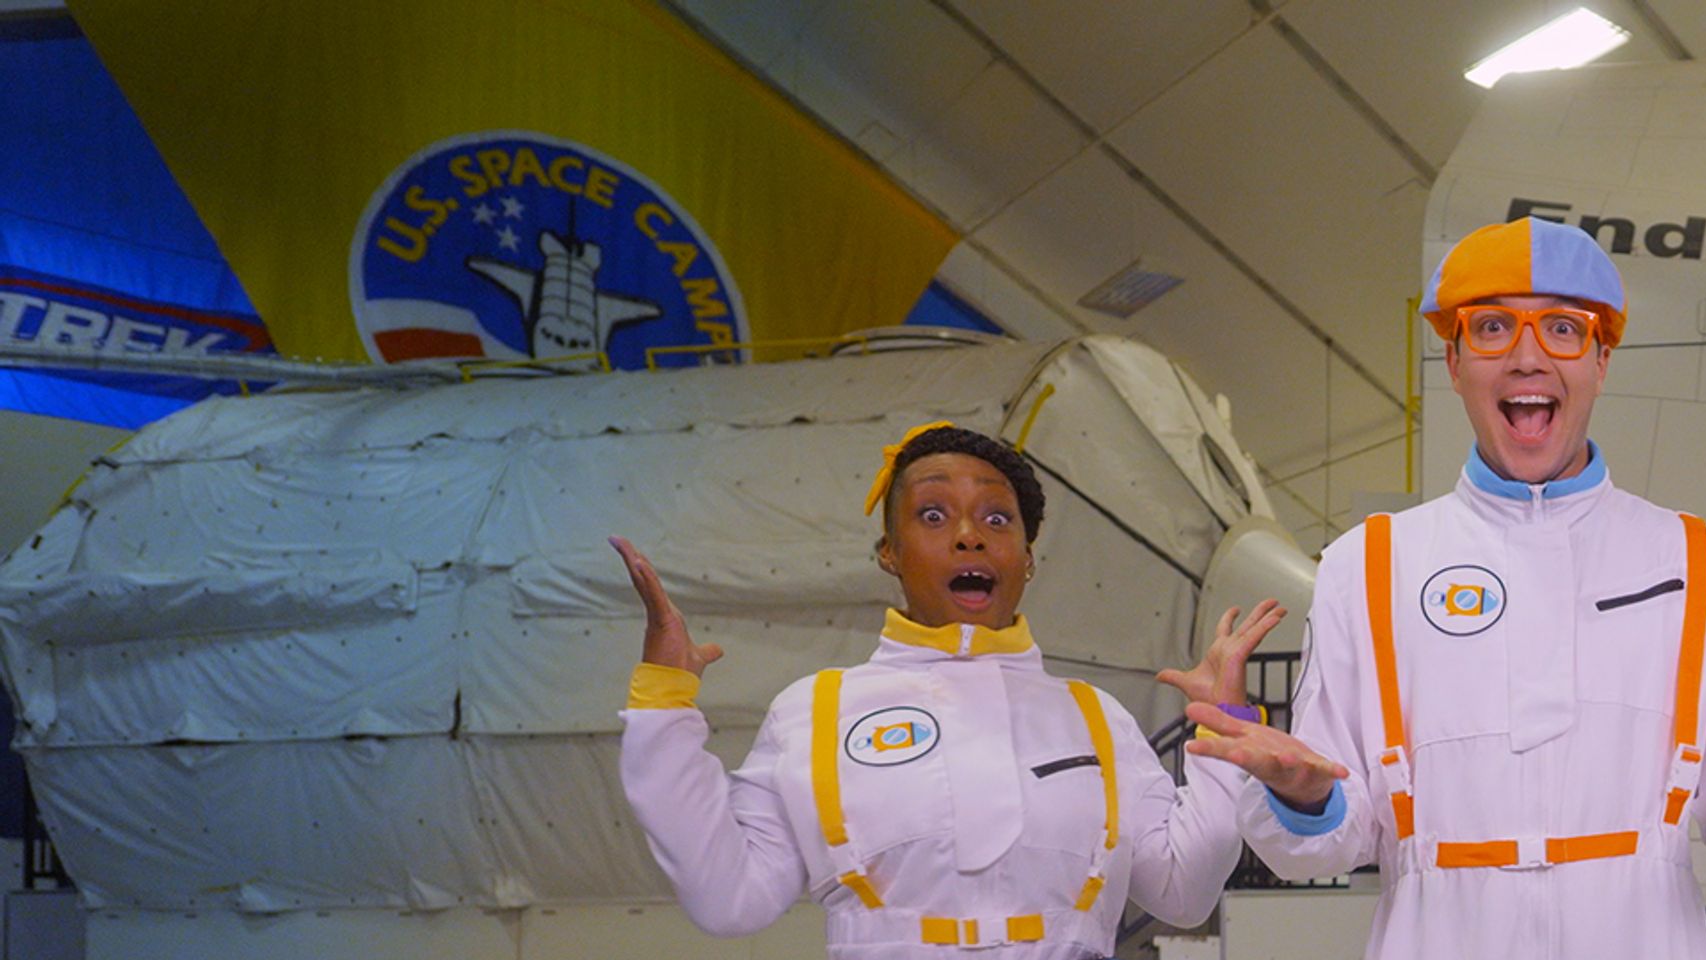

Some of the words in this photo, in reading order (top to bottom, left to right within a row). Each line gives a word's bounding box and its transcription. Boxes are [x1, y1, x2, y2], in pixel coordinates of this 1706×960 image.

[376, 186, 459, 263] U.S.
[448, 147, 622, 209] SPACE
[634, 203, 734, 350] CAMP
